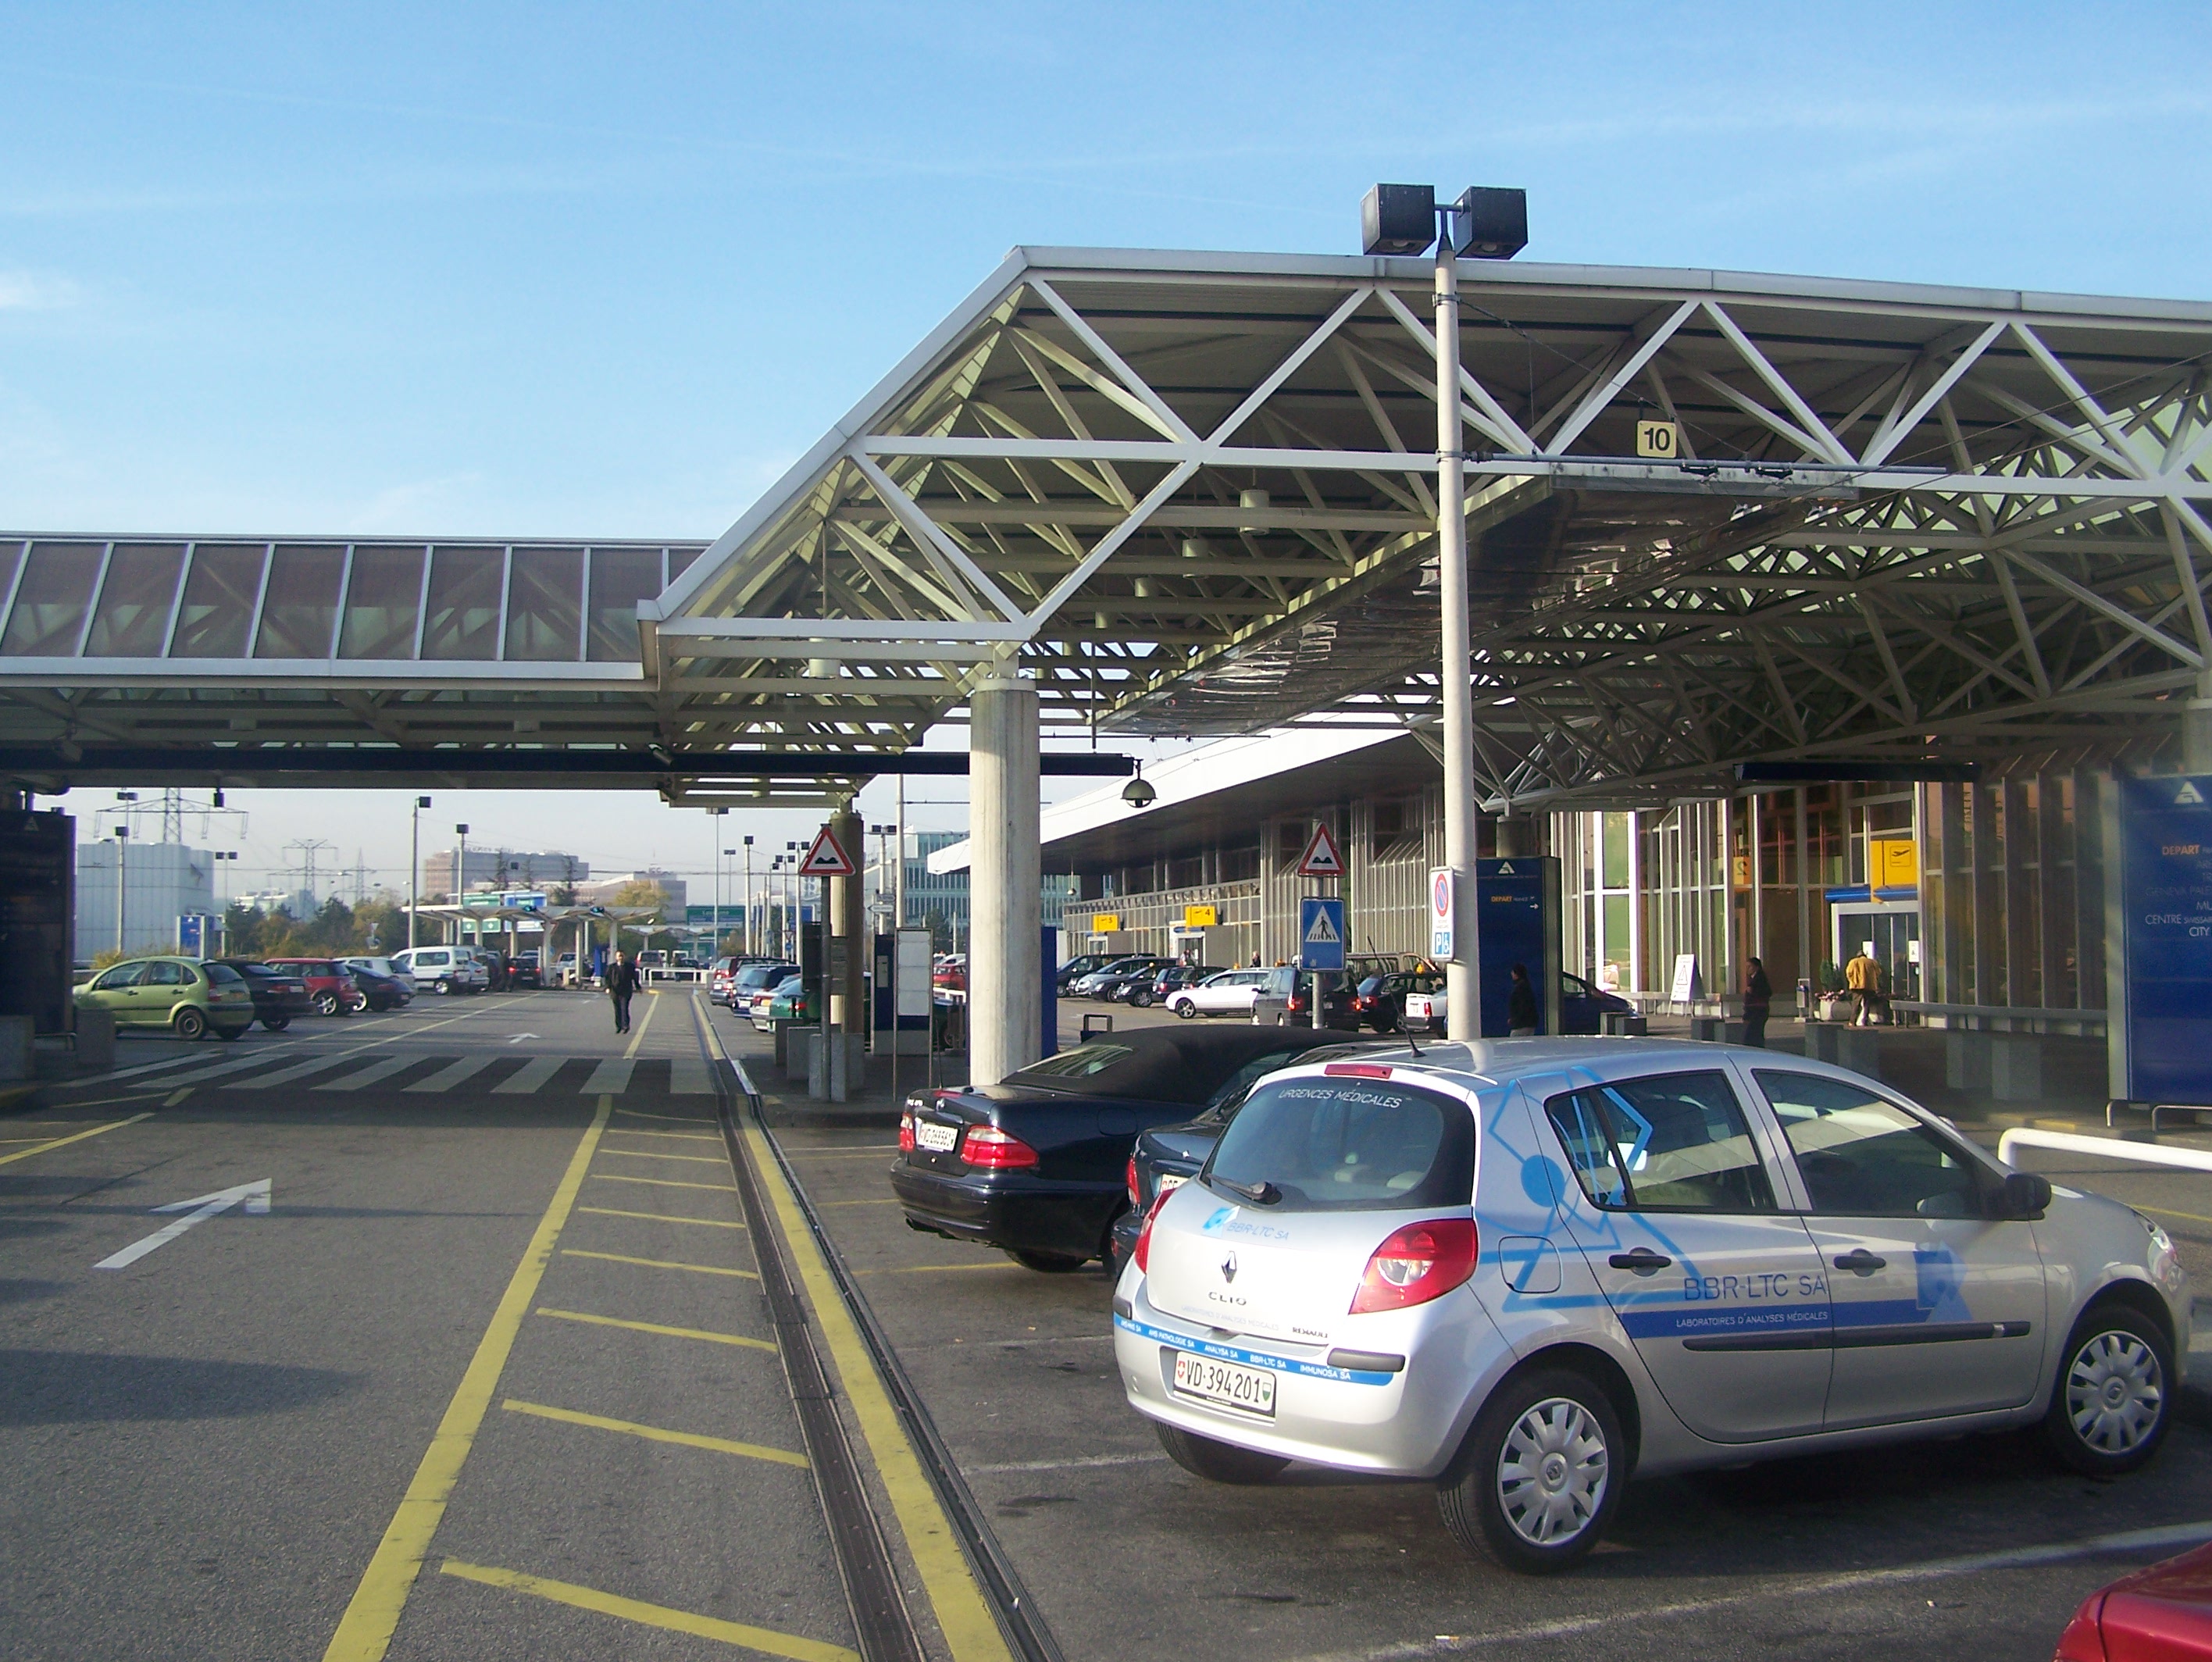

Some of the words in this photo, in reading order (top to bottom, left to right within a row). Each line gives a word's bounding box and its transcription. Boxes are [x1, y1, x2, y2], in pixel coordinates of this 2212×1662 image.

[1643, 427, 1670, 451] 10
[2162, 844, 2200, 855] DEPART
[2145, 915, 2182, 925] CENTRE
[2189, 926, 2210, 937] CITY
[1278, 1089, 1334, 1100] URGENCES
[1334, 1089, 1402, 1108] MÉDICALES
[1227, 1222, 1274, 1237] BBR-LTC
[1275, 1230, 1289, 1240] SA
[1684, 1274, 1789, 1301] BBR-LTC
[1799, 1275, 1827, 1296] SA
[1208, 1291, 1247, 1306] CLIO
[1676, 1318, 1736, 1328] LABORATOIRES
[1186, 1339, 1195, 1348] SA
[1229, 1350, 1239, 1359] SA
[1276, 1360, 1286, 1368] SA
[1340, 1370, 1351, 1380] SA
